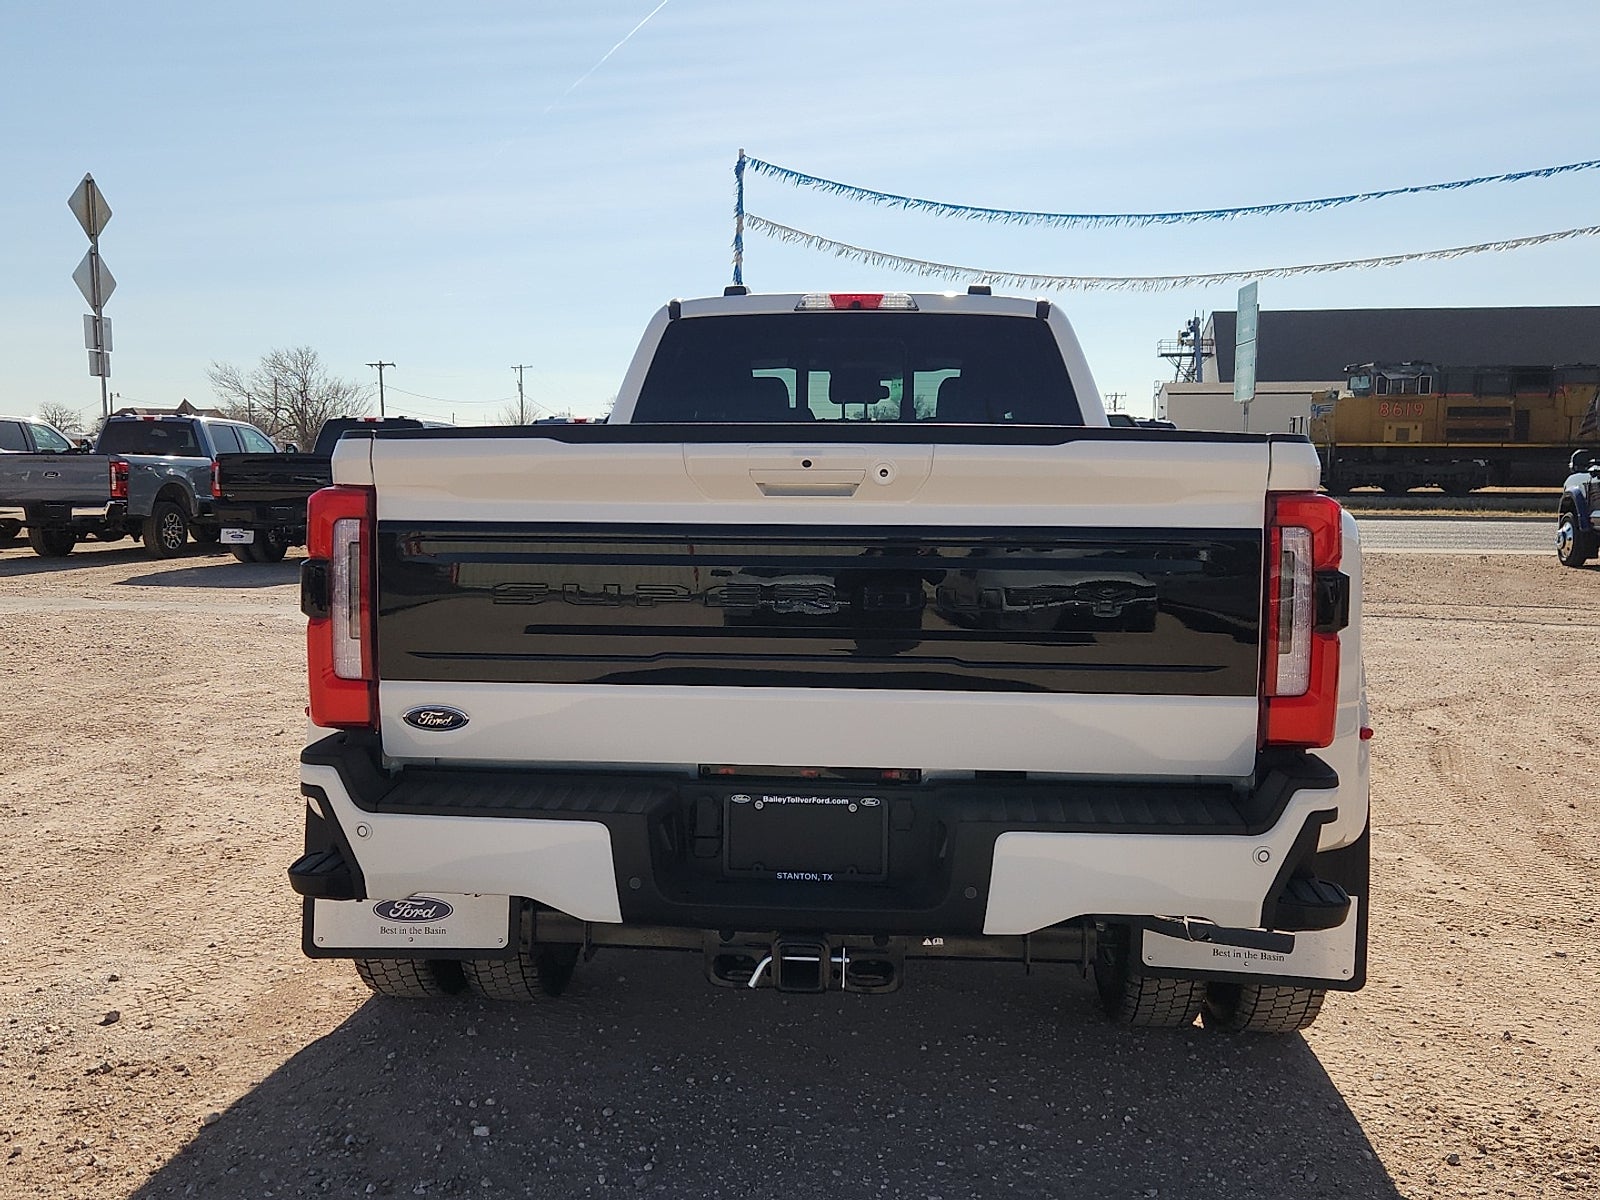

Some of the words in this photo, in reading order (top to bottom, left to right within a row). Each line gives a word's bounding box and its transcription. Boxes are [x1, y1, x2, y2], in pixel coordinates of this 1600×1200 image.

[1379, 401, 1424, 417] 8619
[418, 711, 453, 726] Ford
[776, 872, 820, 882] STANTON,
[821, 873, 834, 881] TX
[389, 900, 436, 918] Ford
[380, 926, 397, 935] Best
[400, 926, 407, 935] in
[409, 926, 423, 935] the
[424, 926, 447, 935] Basin
[1212, 948, 1230, 958] Best
[1232, 950, 1242, 959] in
[1244, 951, 1258, 960] the
[1260, 952, 1285, 962] Basin
